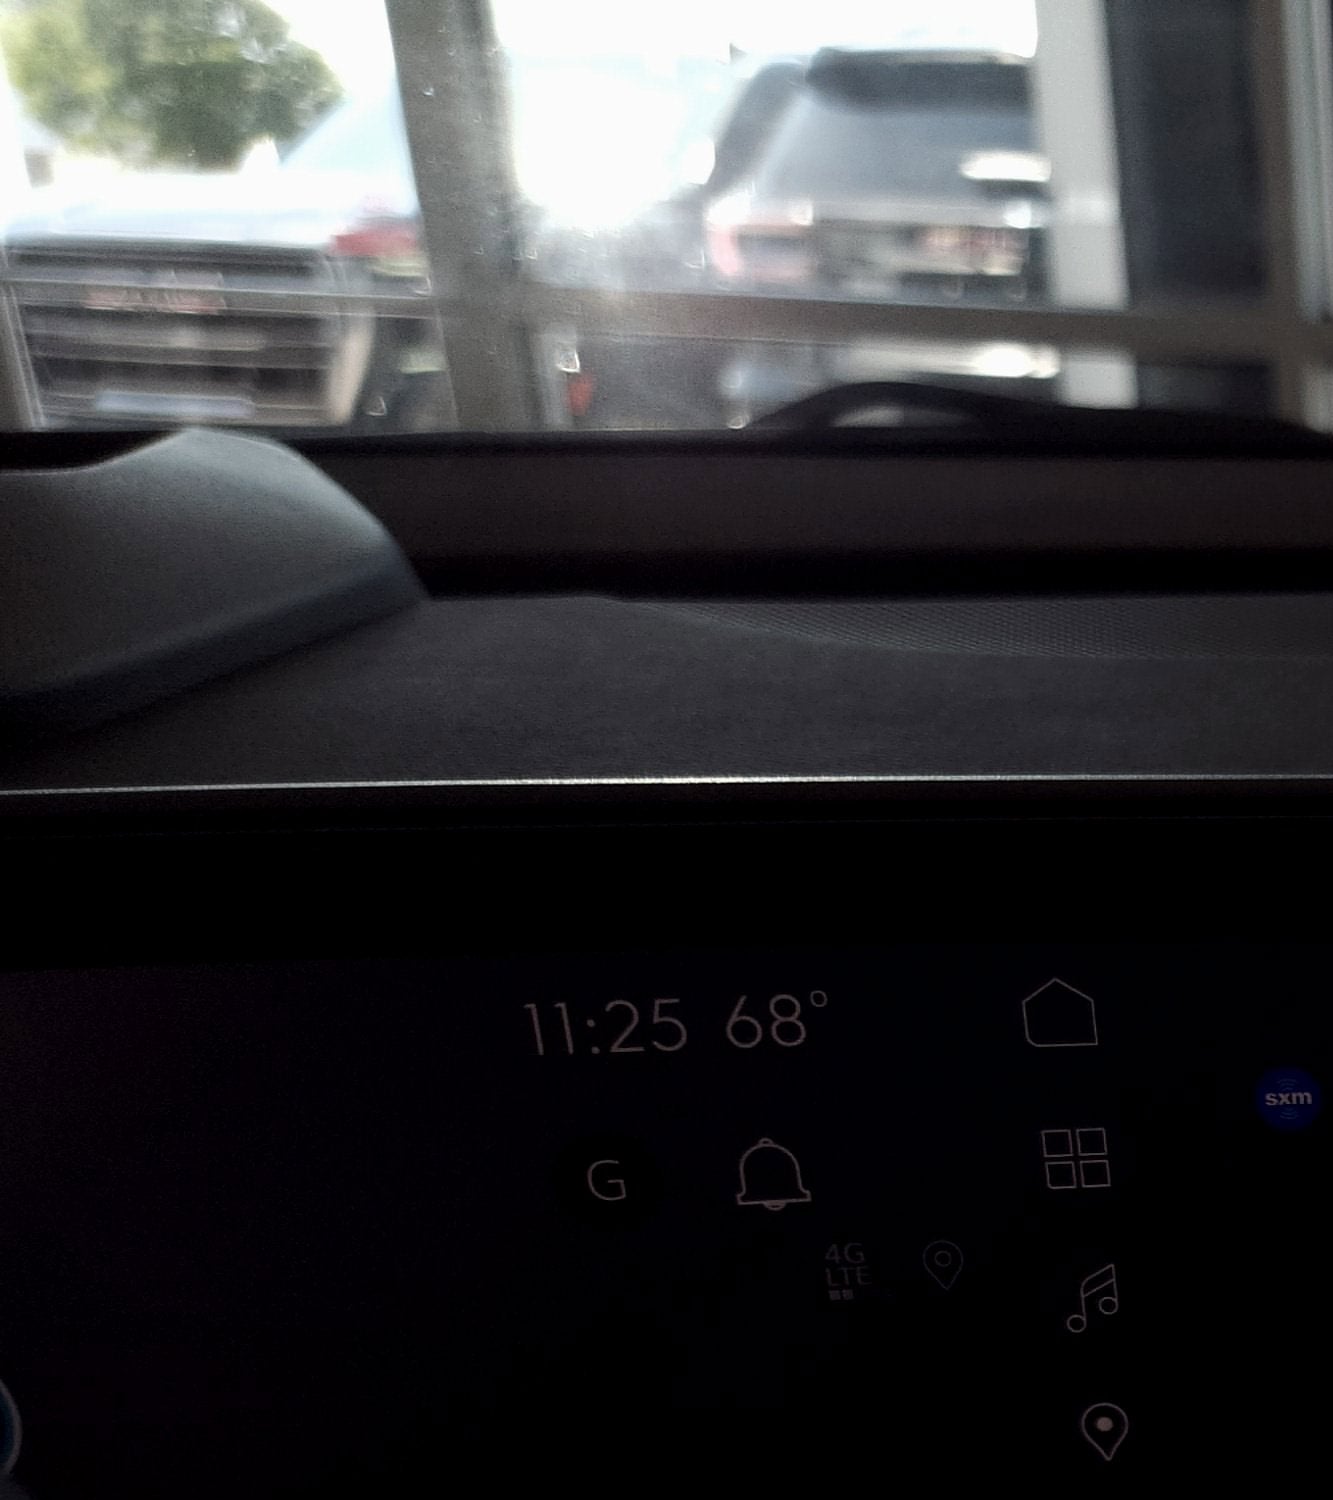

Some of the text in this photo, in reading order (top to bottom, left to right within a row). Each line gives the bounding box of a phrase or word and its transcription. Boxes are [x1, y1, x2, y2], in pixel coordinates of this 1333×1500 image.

[524, 990, 828, 1055] 11:25 68°
[1264, 1088, 1313, 1107] sxm
[824, 1241, 867, 1264] 4G
[824, 1264, 873, 1287] LTE
